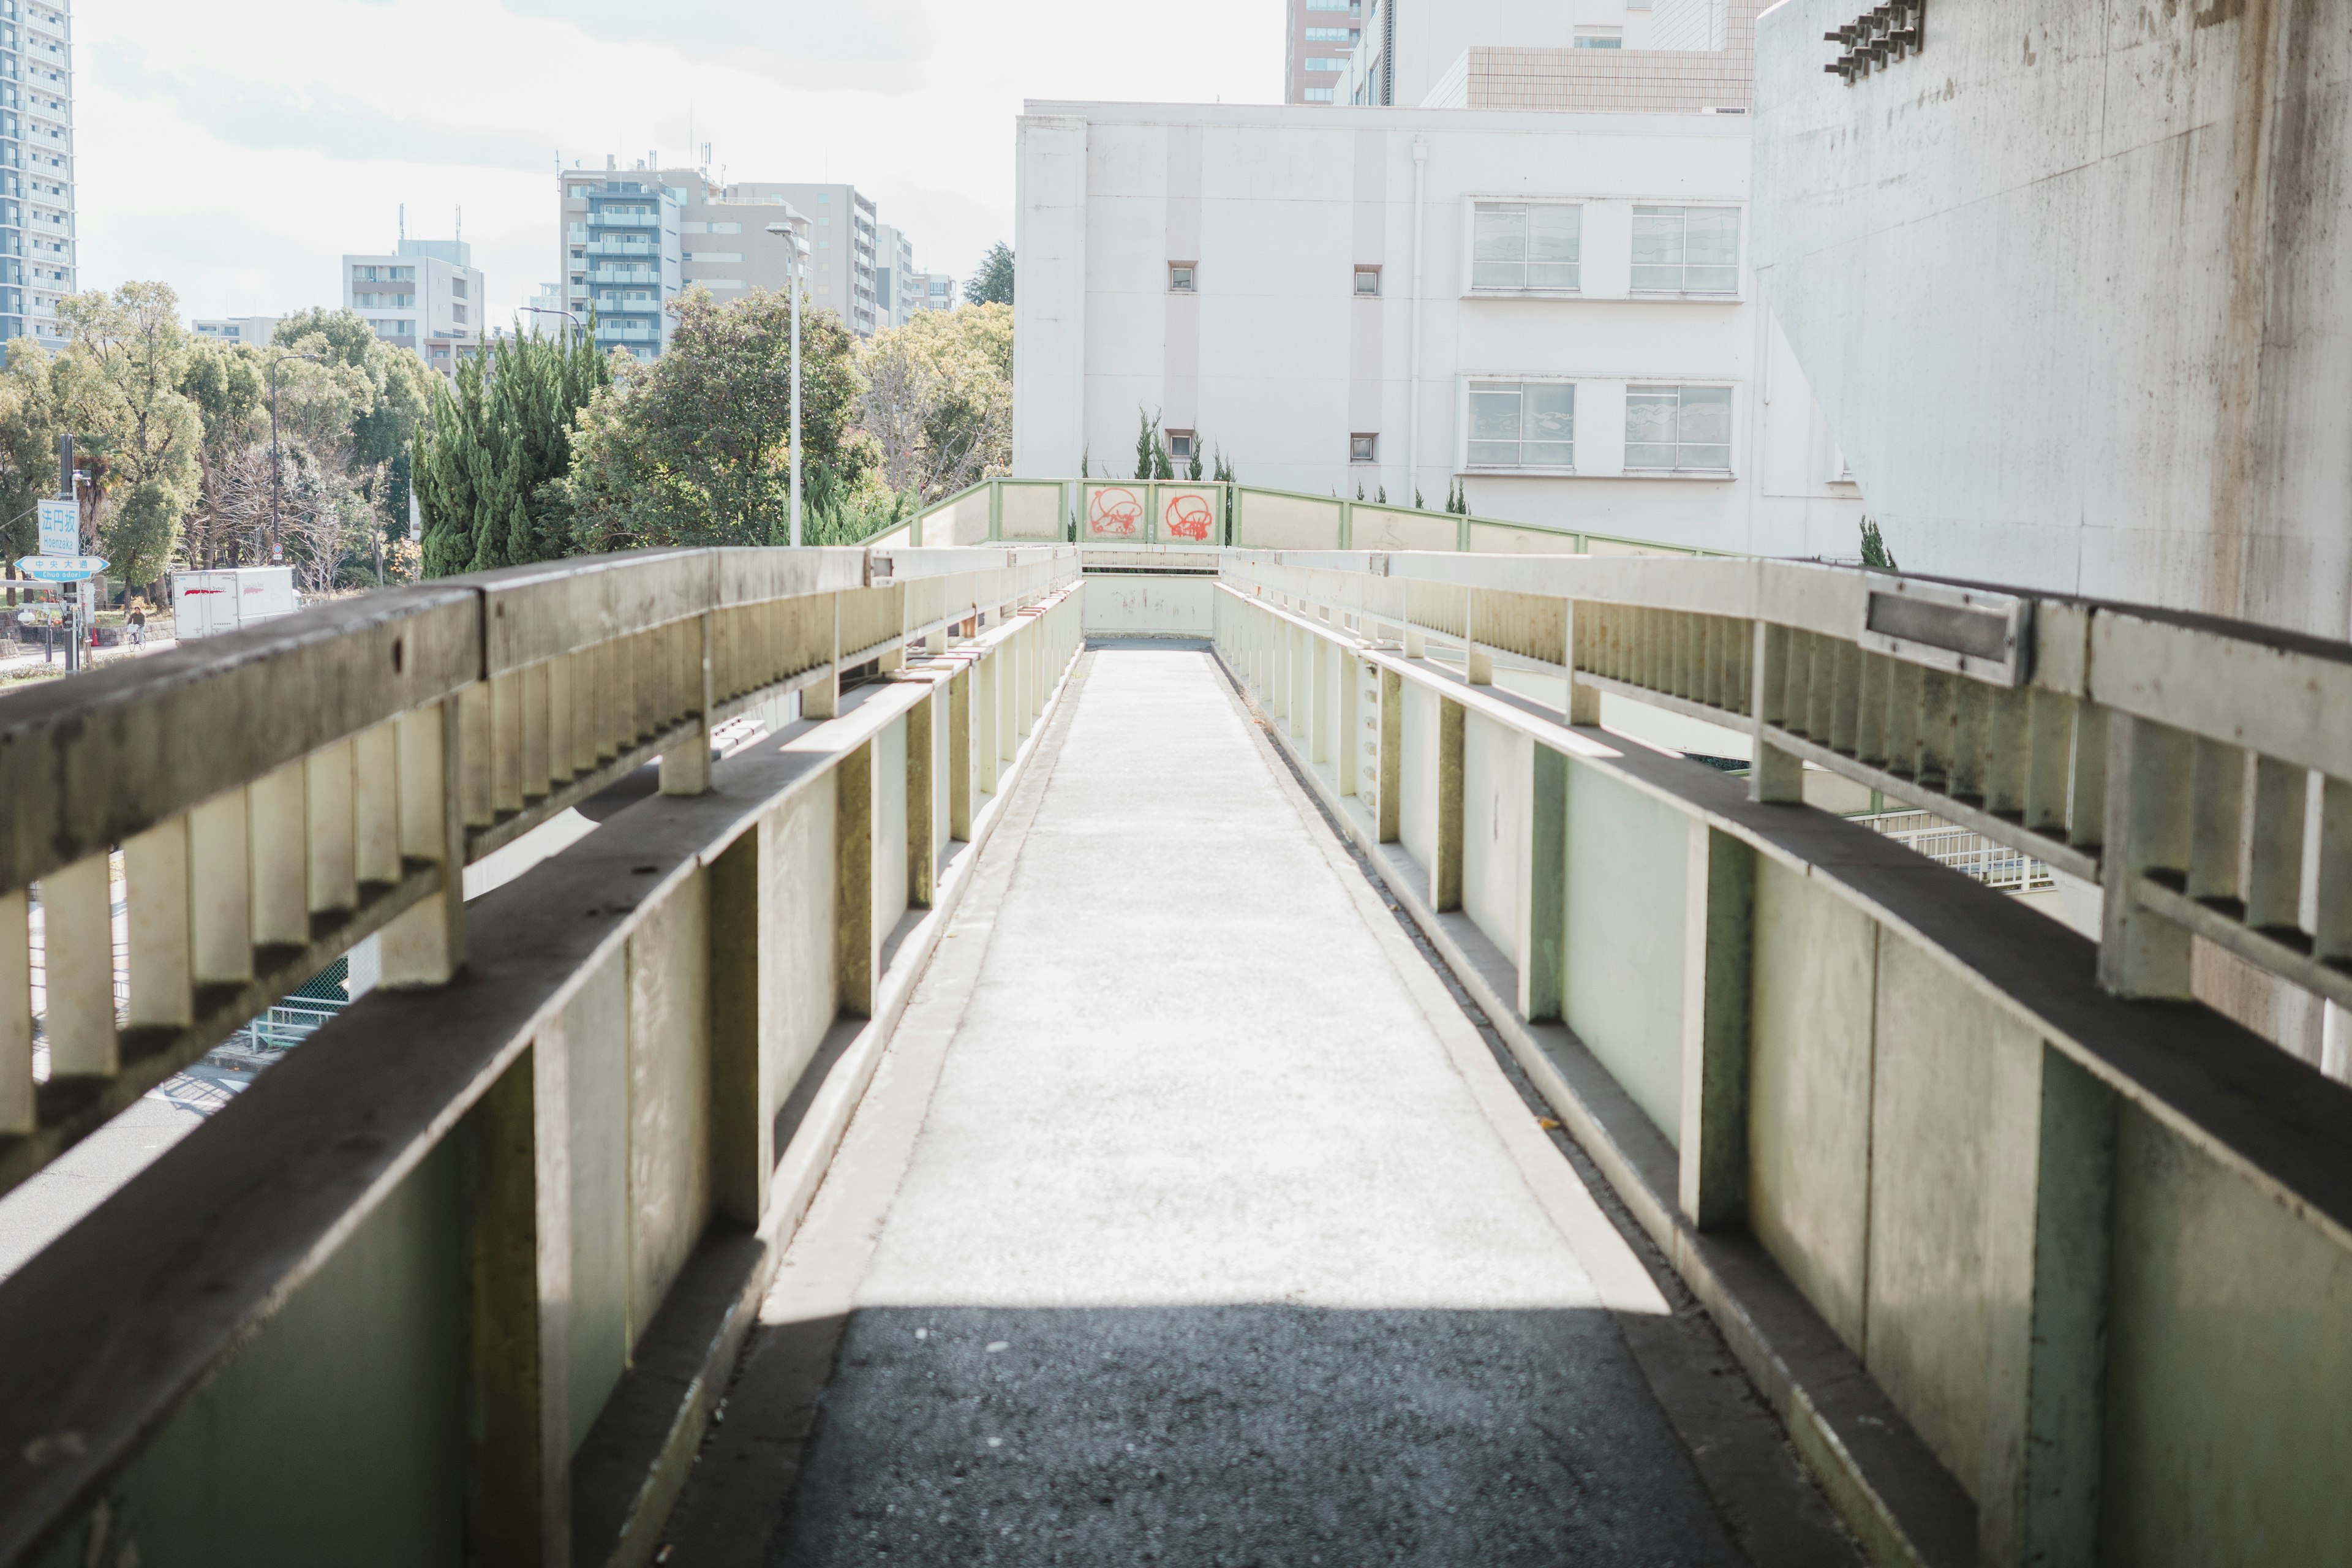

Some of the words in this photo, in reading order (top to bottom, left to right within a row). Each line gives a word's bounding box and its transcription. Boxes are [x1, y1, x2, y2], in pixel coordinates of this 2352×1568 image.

[42, 508, 75, 533] 法円坂
[43, 535, 73, 550] Hoenzaka
[36, 560, 88, 569] 中央大通
